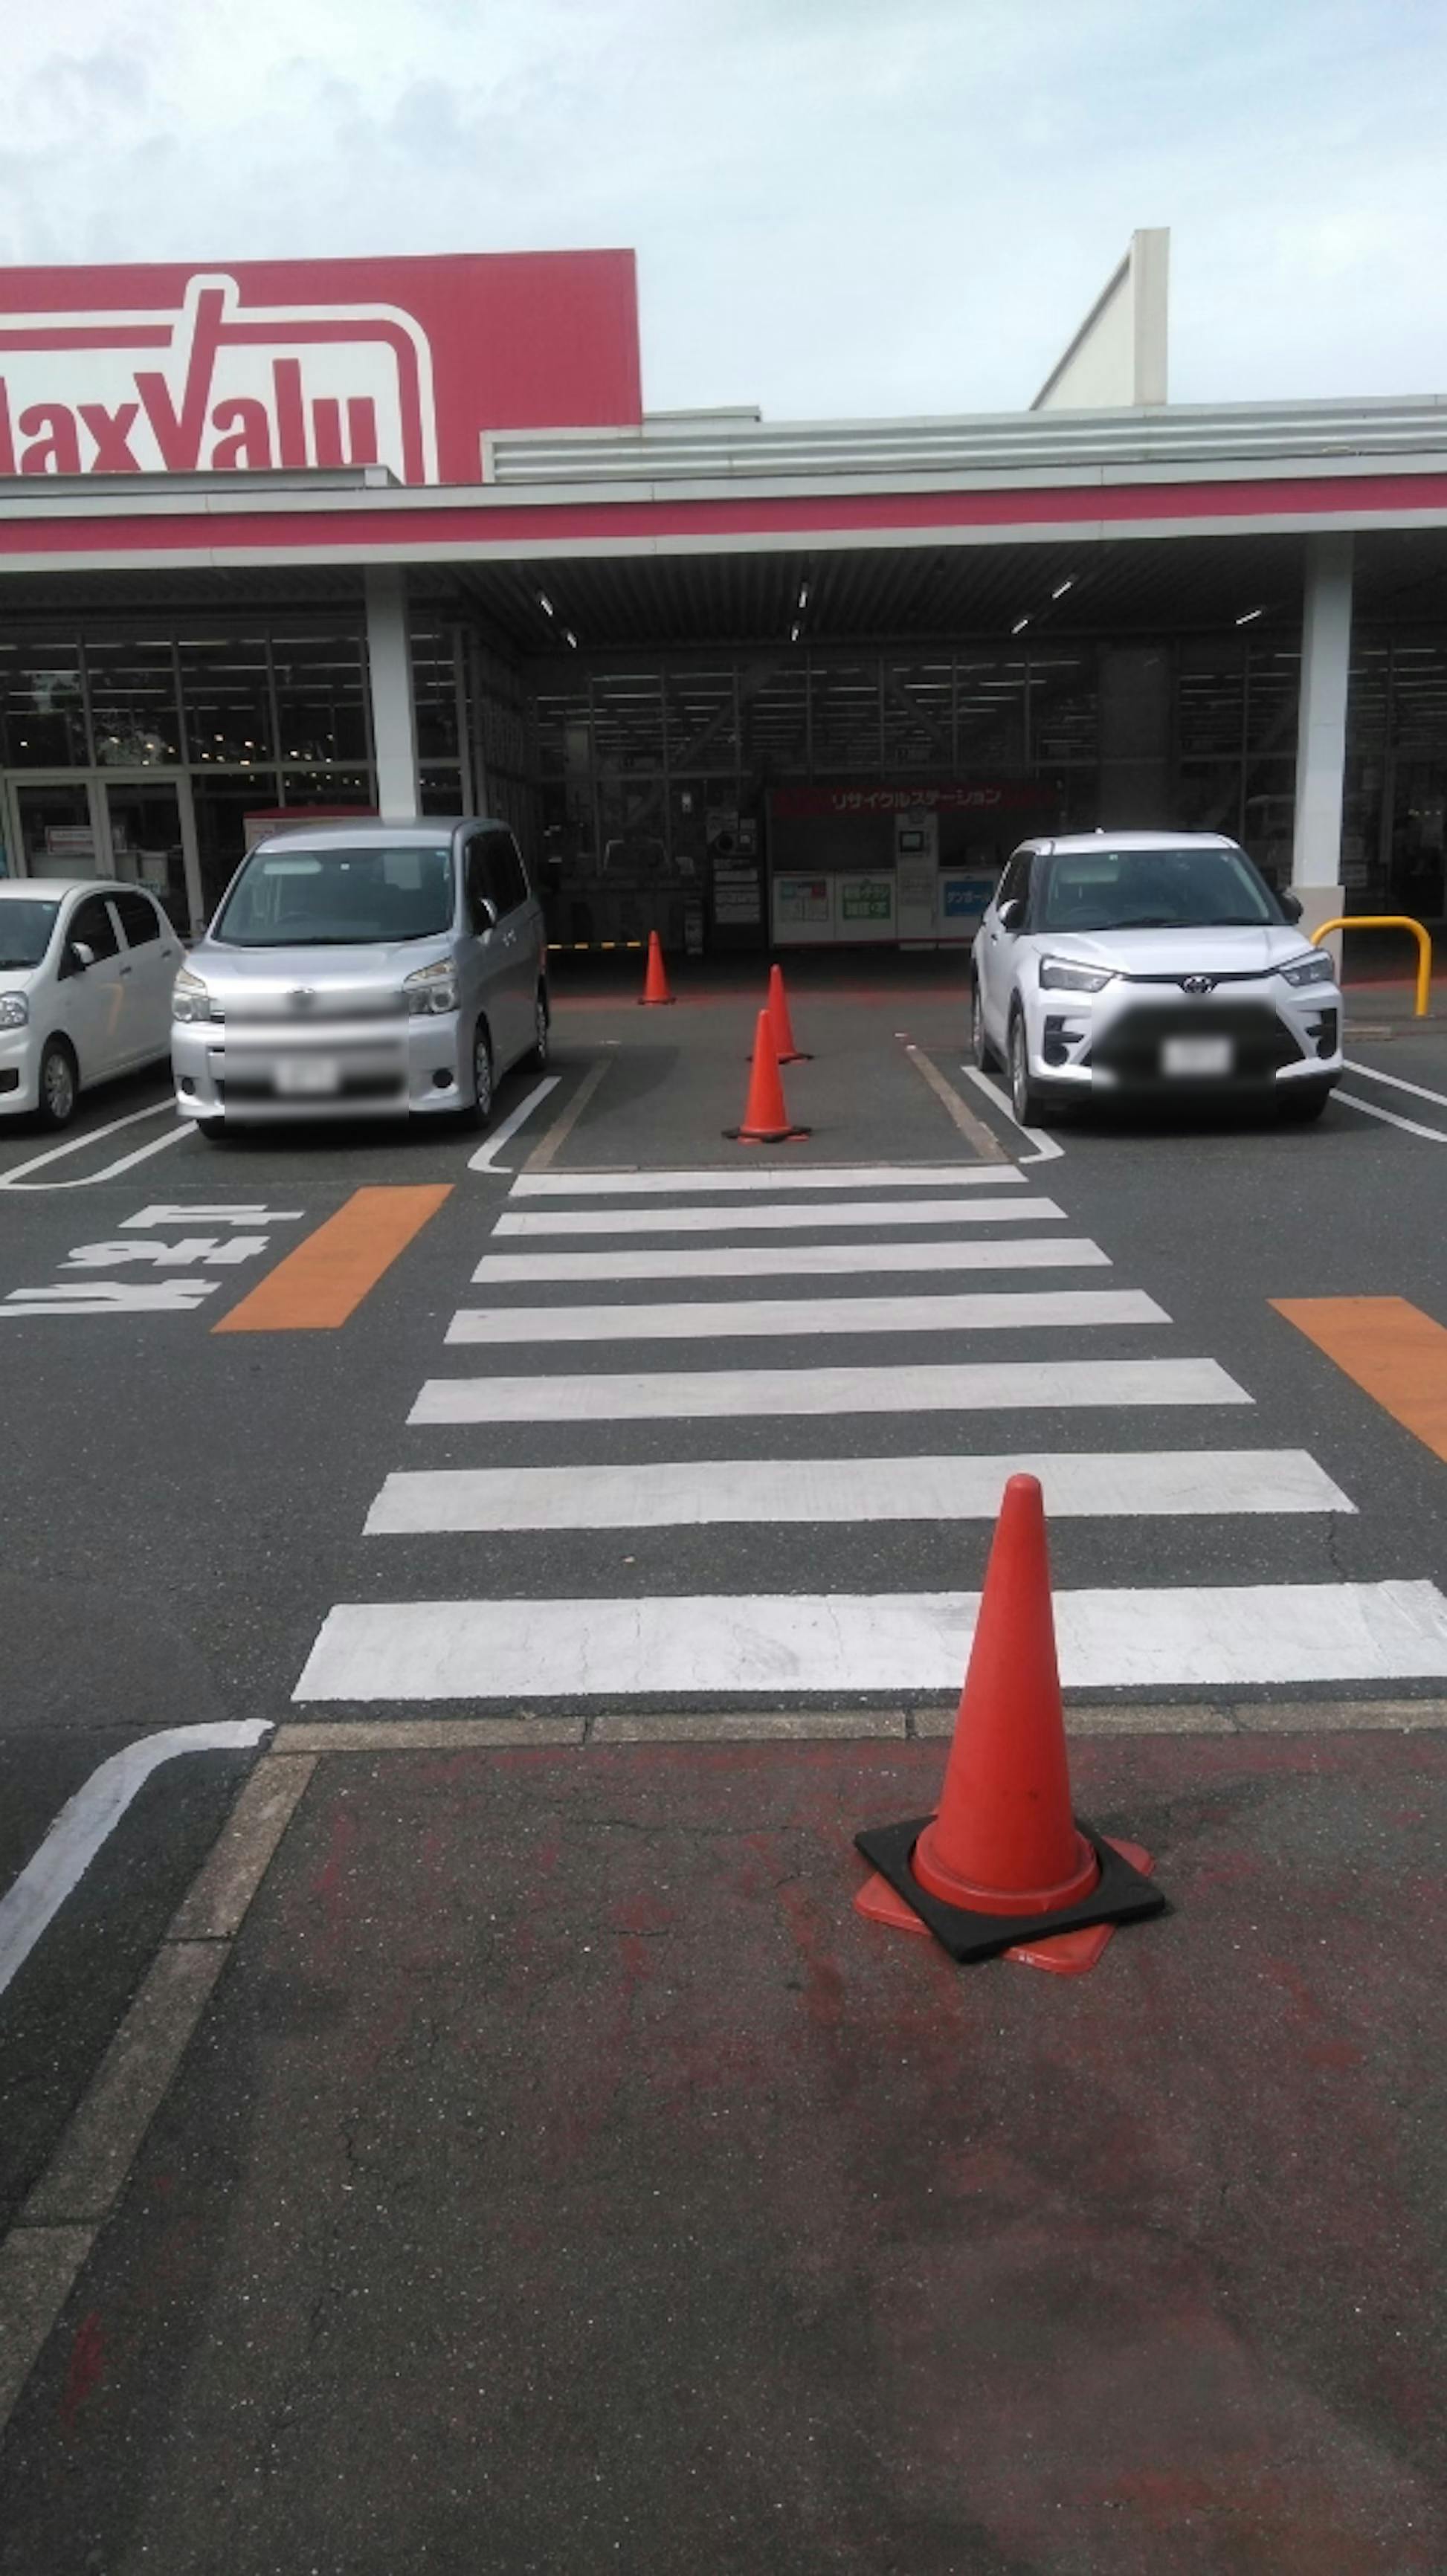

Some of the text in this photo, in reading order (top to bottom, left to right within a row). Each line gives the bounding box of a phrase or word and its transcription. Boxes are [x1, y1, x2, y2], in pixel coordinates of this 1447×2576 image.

[0, 288, 378, 474] axValu
[833, 789, 1001, 810] リサイクルステーション
